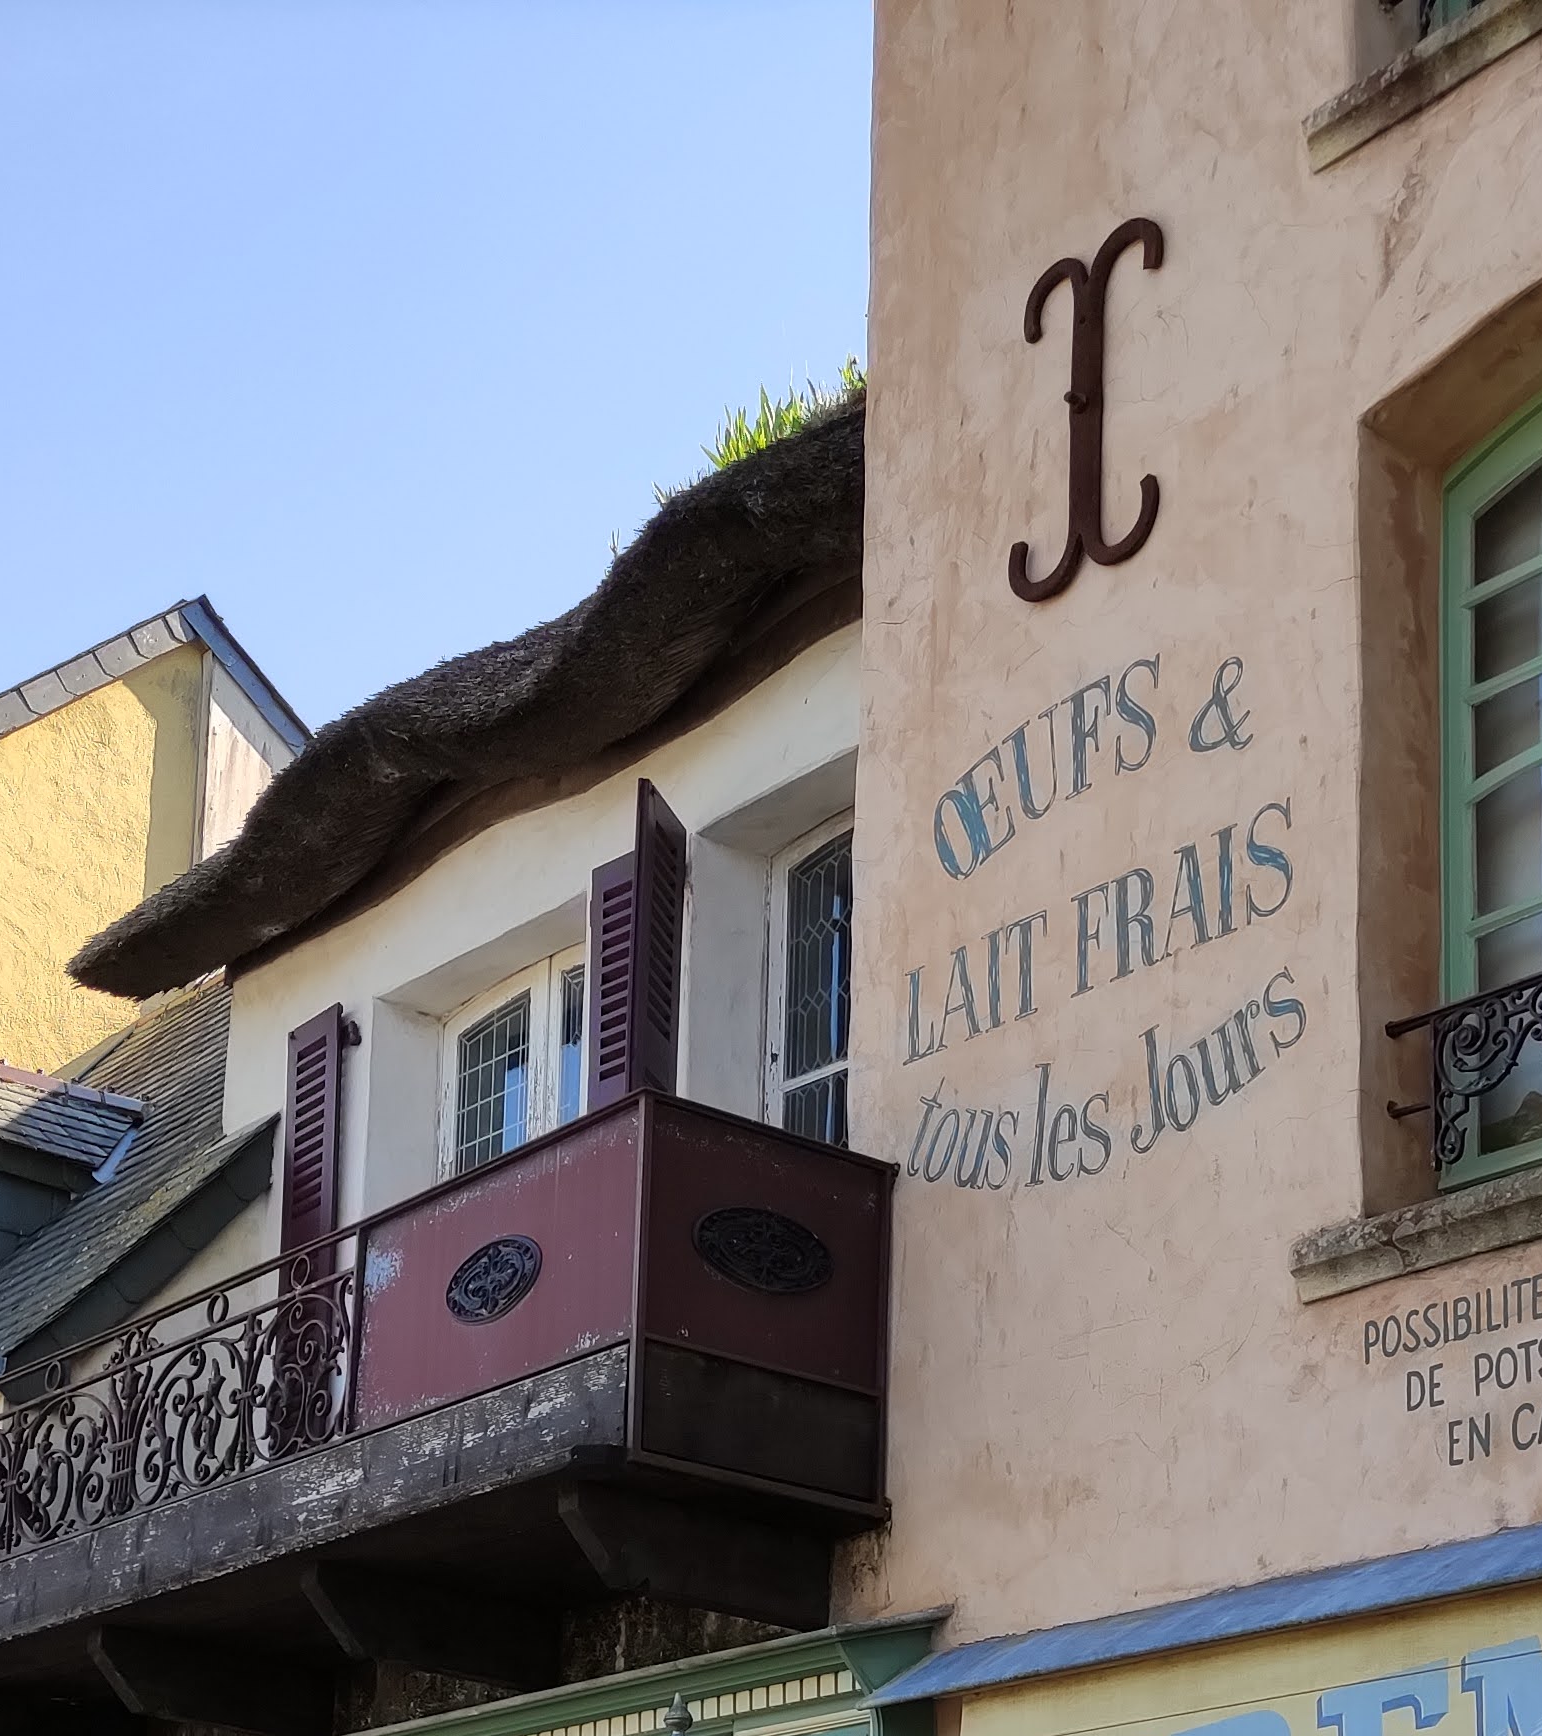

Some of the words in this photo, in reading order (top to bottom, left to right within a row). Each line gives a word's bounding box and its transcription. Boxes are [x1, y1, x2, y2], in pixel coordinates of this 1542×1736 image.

[933, 654, 1160, 880] ŒUFS
[1188, 656, 1253, 752] &
[903, 910, 1048, 1066] LAIT
[1071, 797, 1293, 998] FRAIS
[907, 1077, 1020, 1190] tous
[1025, 1063, 1112, 1188] les
[1405, 1364, 1444, 1412] DE
[1448, 1413, 1492, 1466] EN
